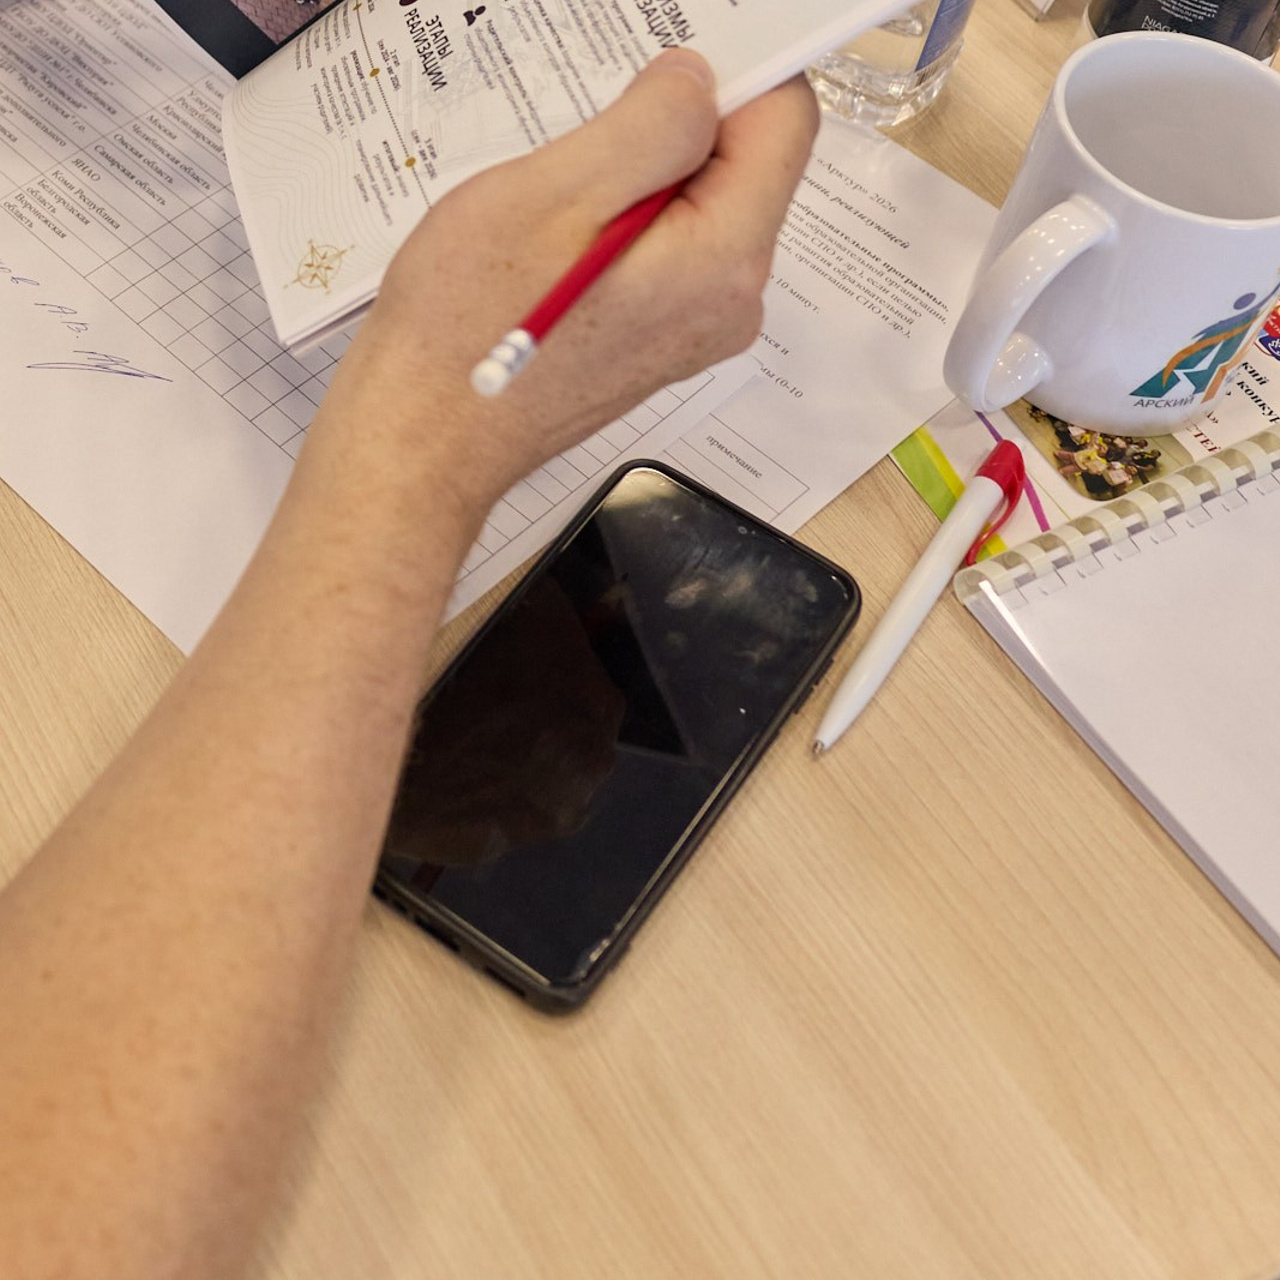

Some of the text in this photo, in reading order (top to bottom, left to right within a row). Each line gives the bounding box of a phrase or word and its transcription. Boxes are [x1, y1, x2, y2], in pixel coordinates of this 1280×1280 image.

[405, 9, 446, 90] РЕАЛИЗАЦИИ
[426, 15, 453, 59] ЭТАПЫ
[487, 19, 512, 65] Родительский
[544, 18, 564, 48] качества:
[147, 115, 177, 140] Москва
[163, 106, 223, 153] Краснодарский
[72, 158, 100, 181] ЯНАО
[94, 145, 165, 205] Самарская область
[114, 134, 173, 184] Омская область
[132, 124, 210, 189] Челябинская область
[26, 188, 56, 213] область
[38, 180, 90, 225] Белгородская
[52, 170, 120, 229] Коми Республика
[817, 159, 868, 194] «Арктур»
[870, 194, 896, 213] 2026
[3, 202, 33, 228] область
[15, 194, 66, 238] Воронежская
[830, 197, 910, 249] реализующей
[806, 222, 884, 277] образовательной
[776, 278, 818, 313] 10 минут.
[788, 237, 914, 325] развития образовательной
[795, 254, 854, 296] организации
[856, 295, 882, 314] СПО
[811, 237, 836, 255] СПО
[866, 278, 890, 294] если
[890, 294, 922, 317] целью
[775, 377, 803, 398] (0-10
[1133, 394, 1195, 408] АРСКИЙ
[706, 436, 762, 478] примечание
